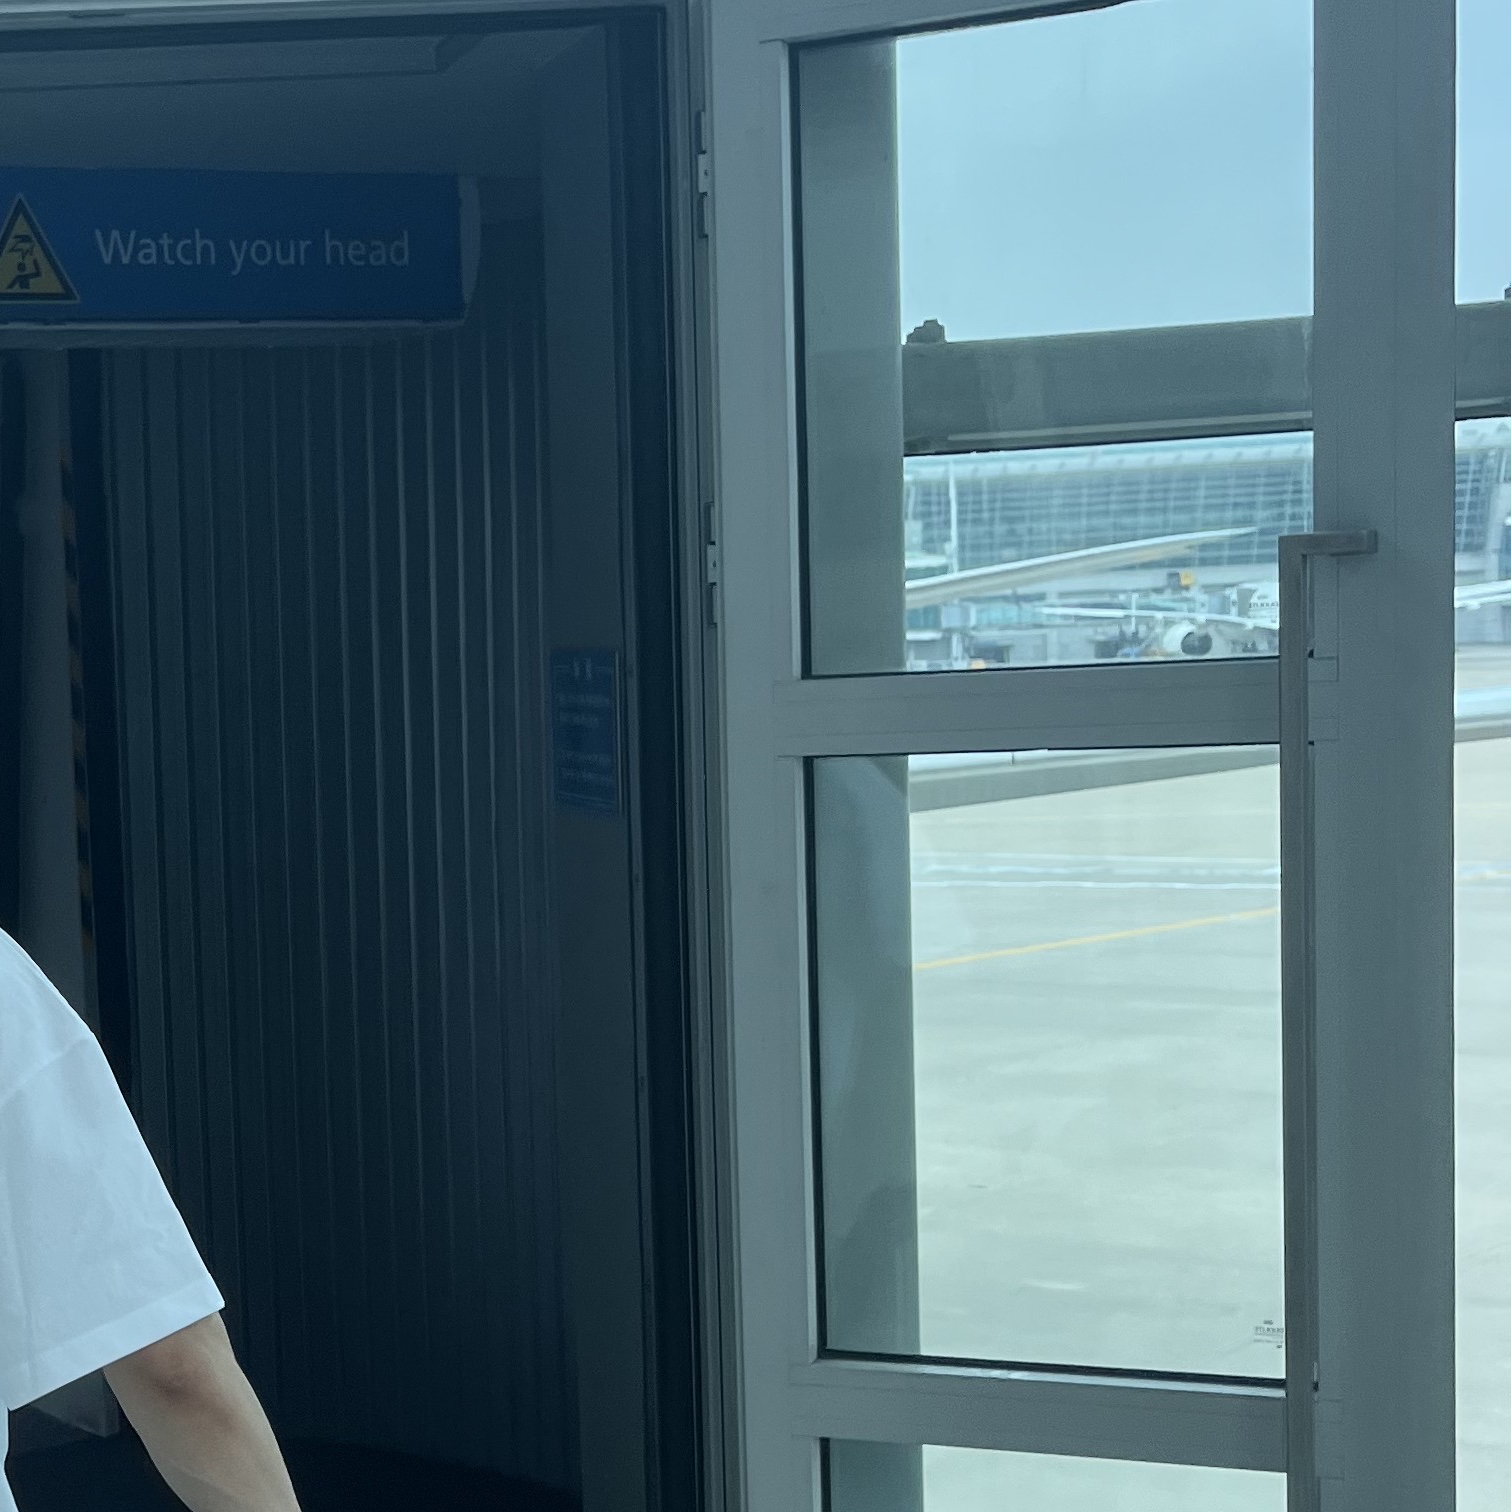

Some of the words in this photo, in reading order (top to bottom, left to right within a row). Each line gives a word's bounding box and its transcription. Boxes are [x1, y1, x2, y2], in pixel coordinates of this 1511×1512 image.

[94, 228, 217, 266] Watch
[228, 238, 312, 277] your
[324, 228, 410, 267] head
